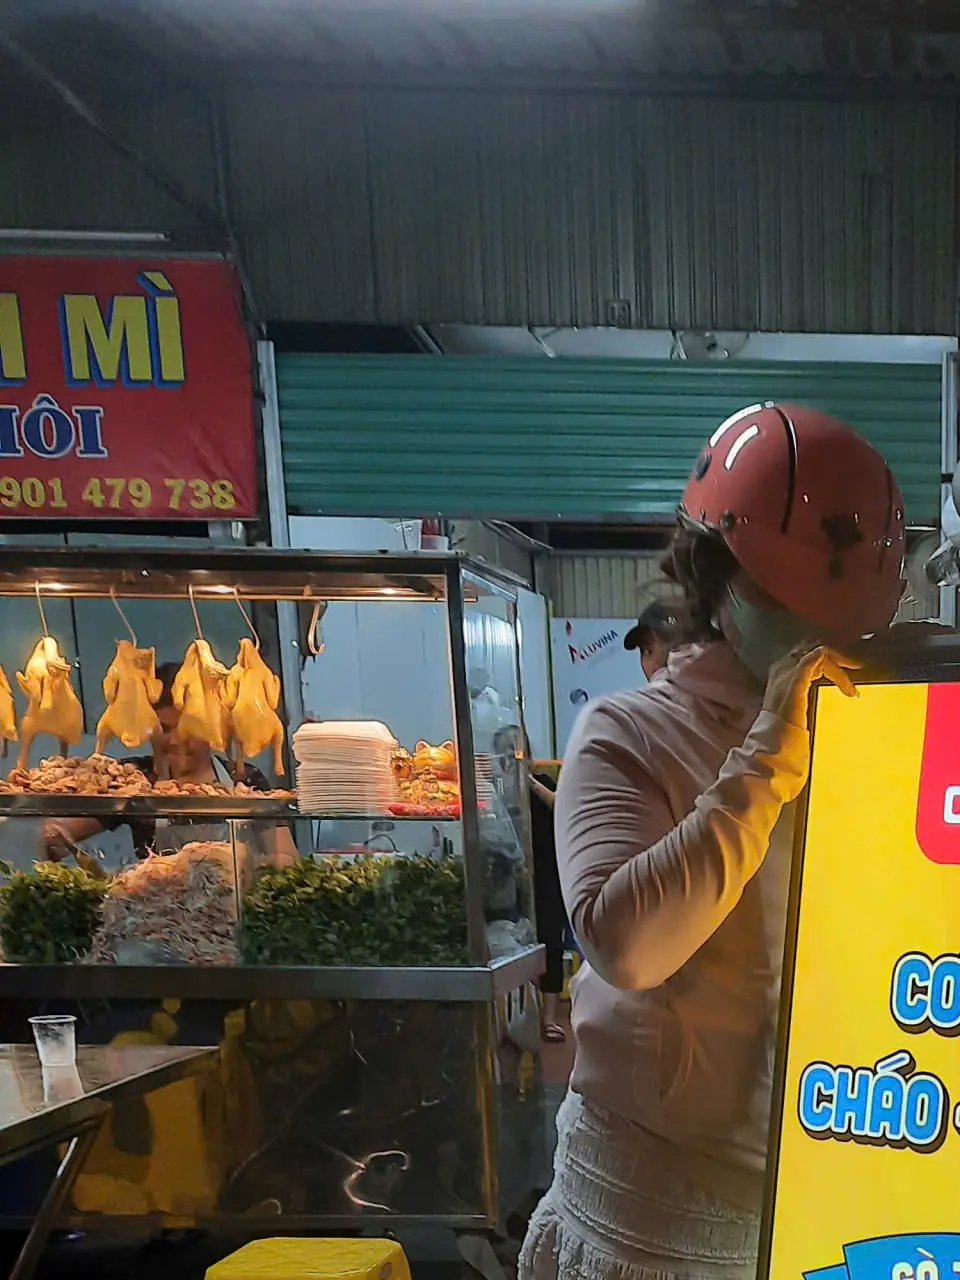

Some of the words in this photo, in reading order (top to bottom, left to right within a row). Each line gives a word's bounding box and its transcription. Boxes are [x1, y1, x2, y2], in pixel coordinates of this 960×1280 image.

[58, 271, 186, 389] MÌ
[82, 477, 152, 508] 479
[164, 478, 236, 510] 738
[798, 1049, 950, 1155] CHÁO
